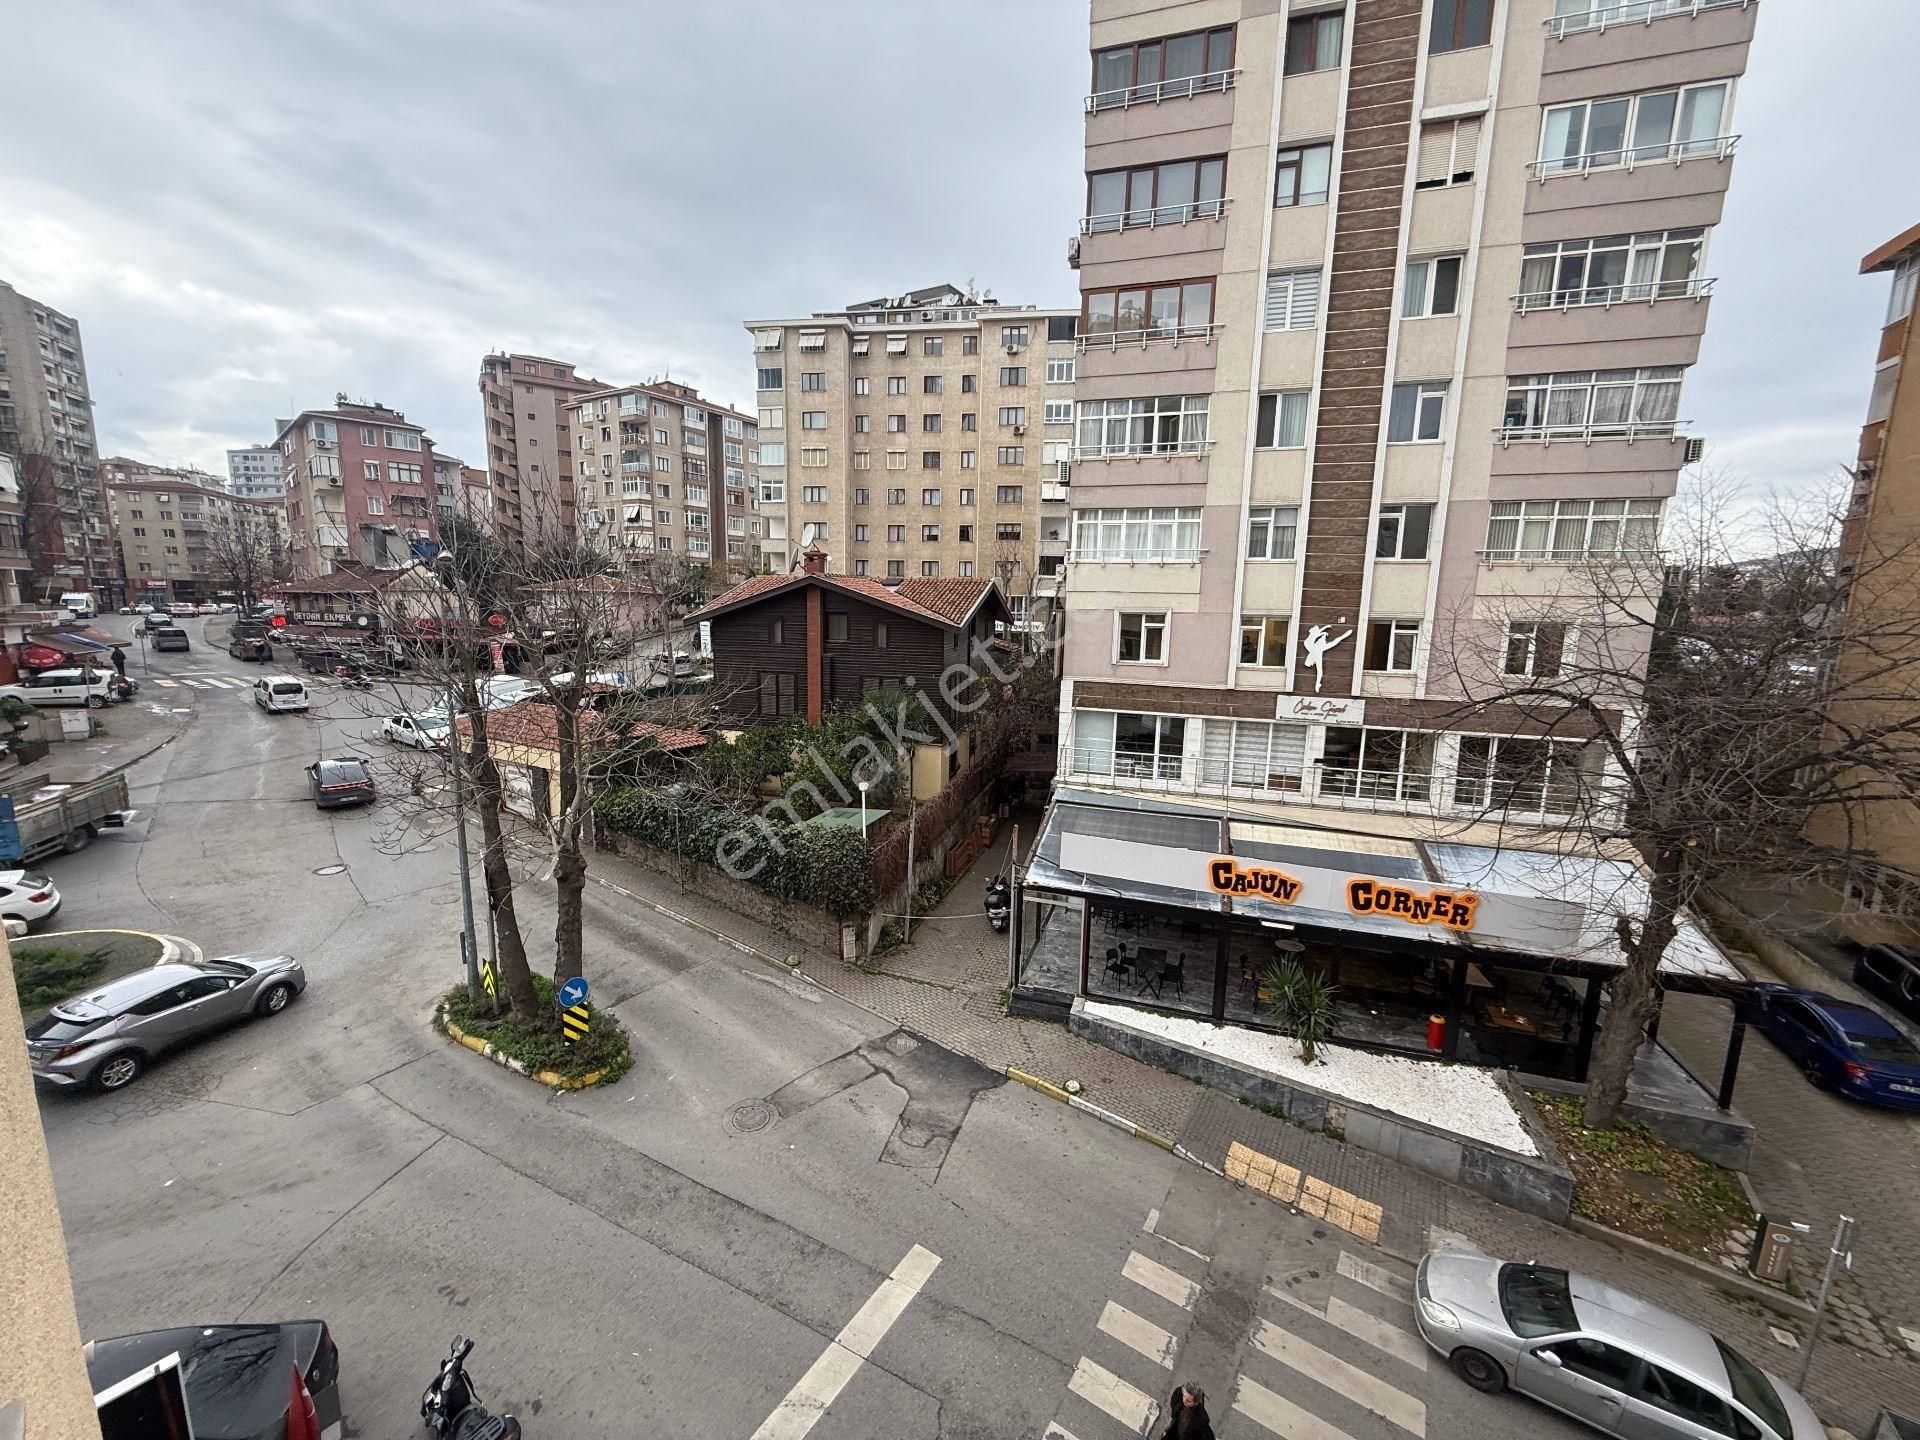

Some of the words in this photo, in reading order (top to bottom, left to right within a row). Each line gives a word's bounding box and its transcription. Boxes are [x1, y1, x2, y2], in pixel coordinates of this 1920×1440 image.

[324, 613, 352, 622] EKMEK
[1210, 860, 1299, 902] CAJUN
[1349, 880, 1471, 927] CORNER
